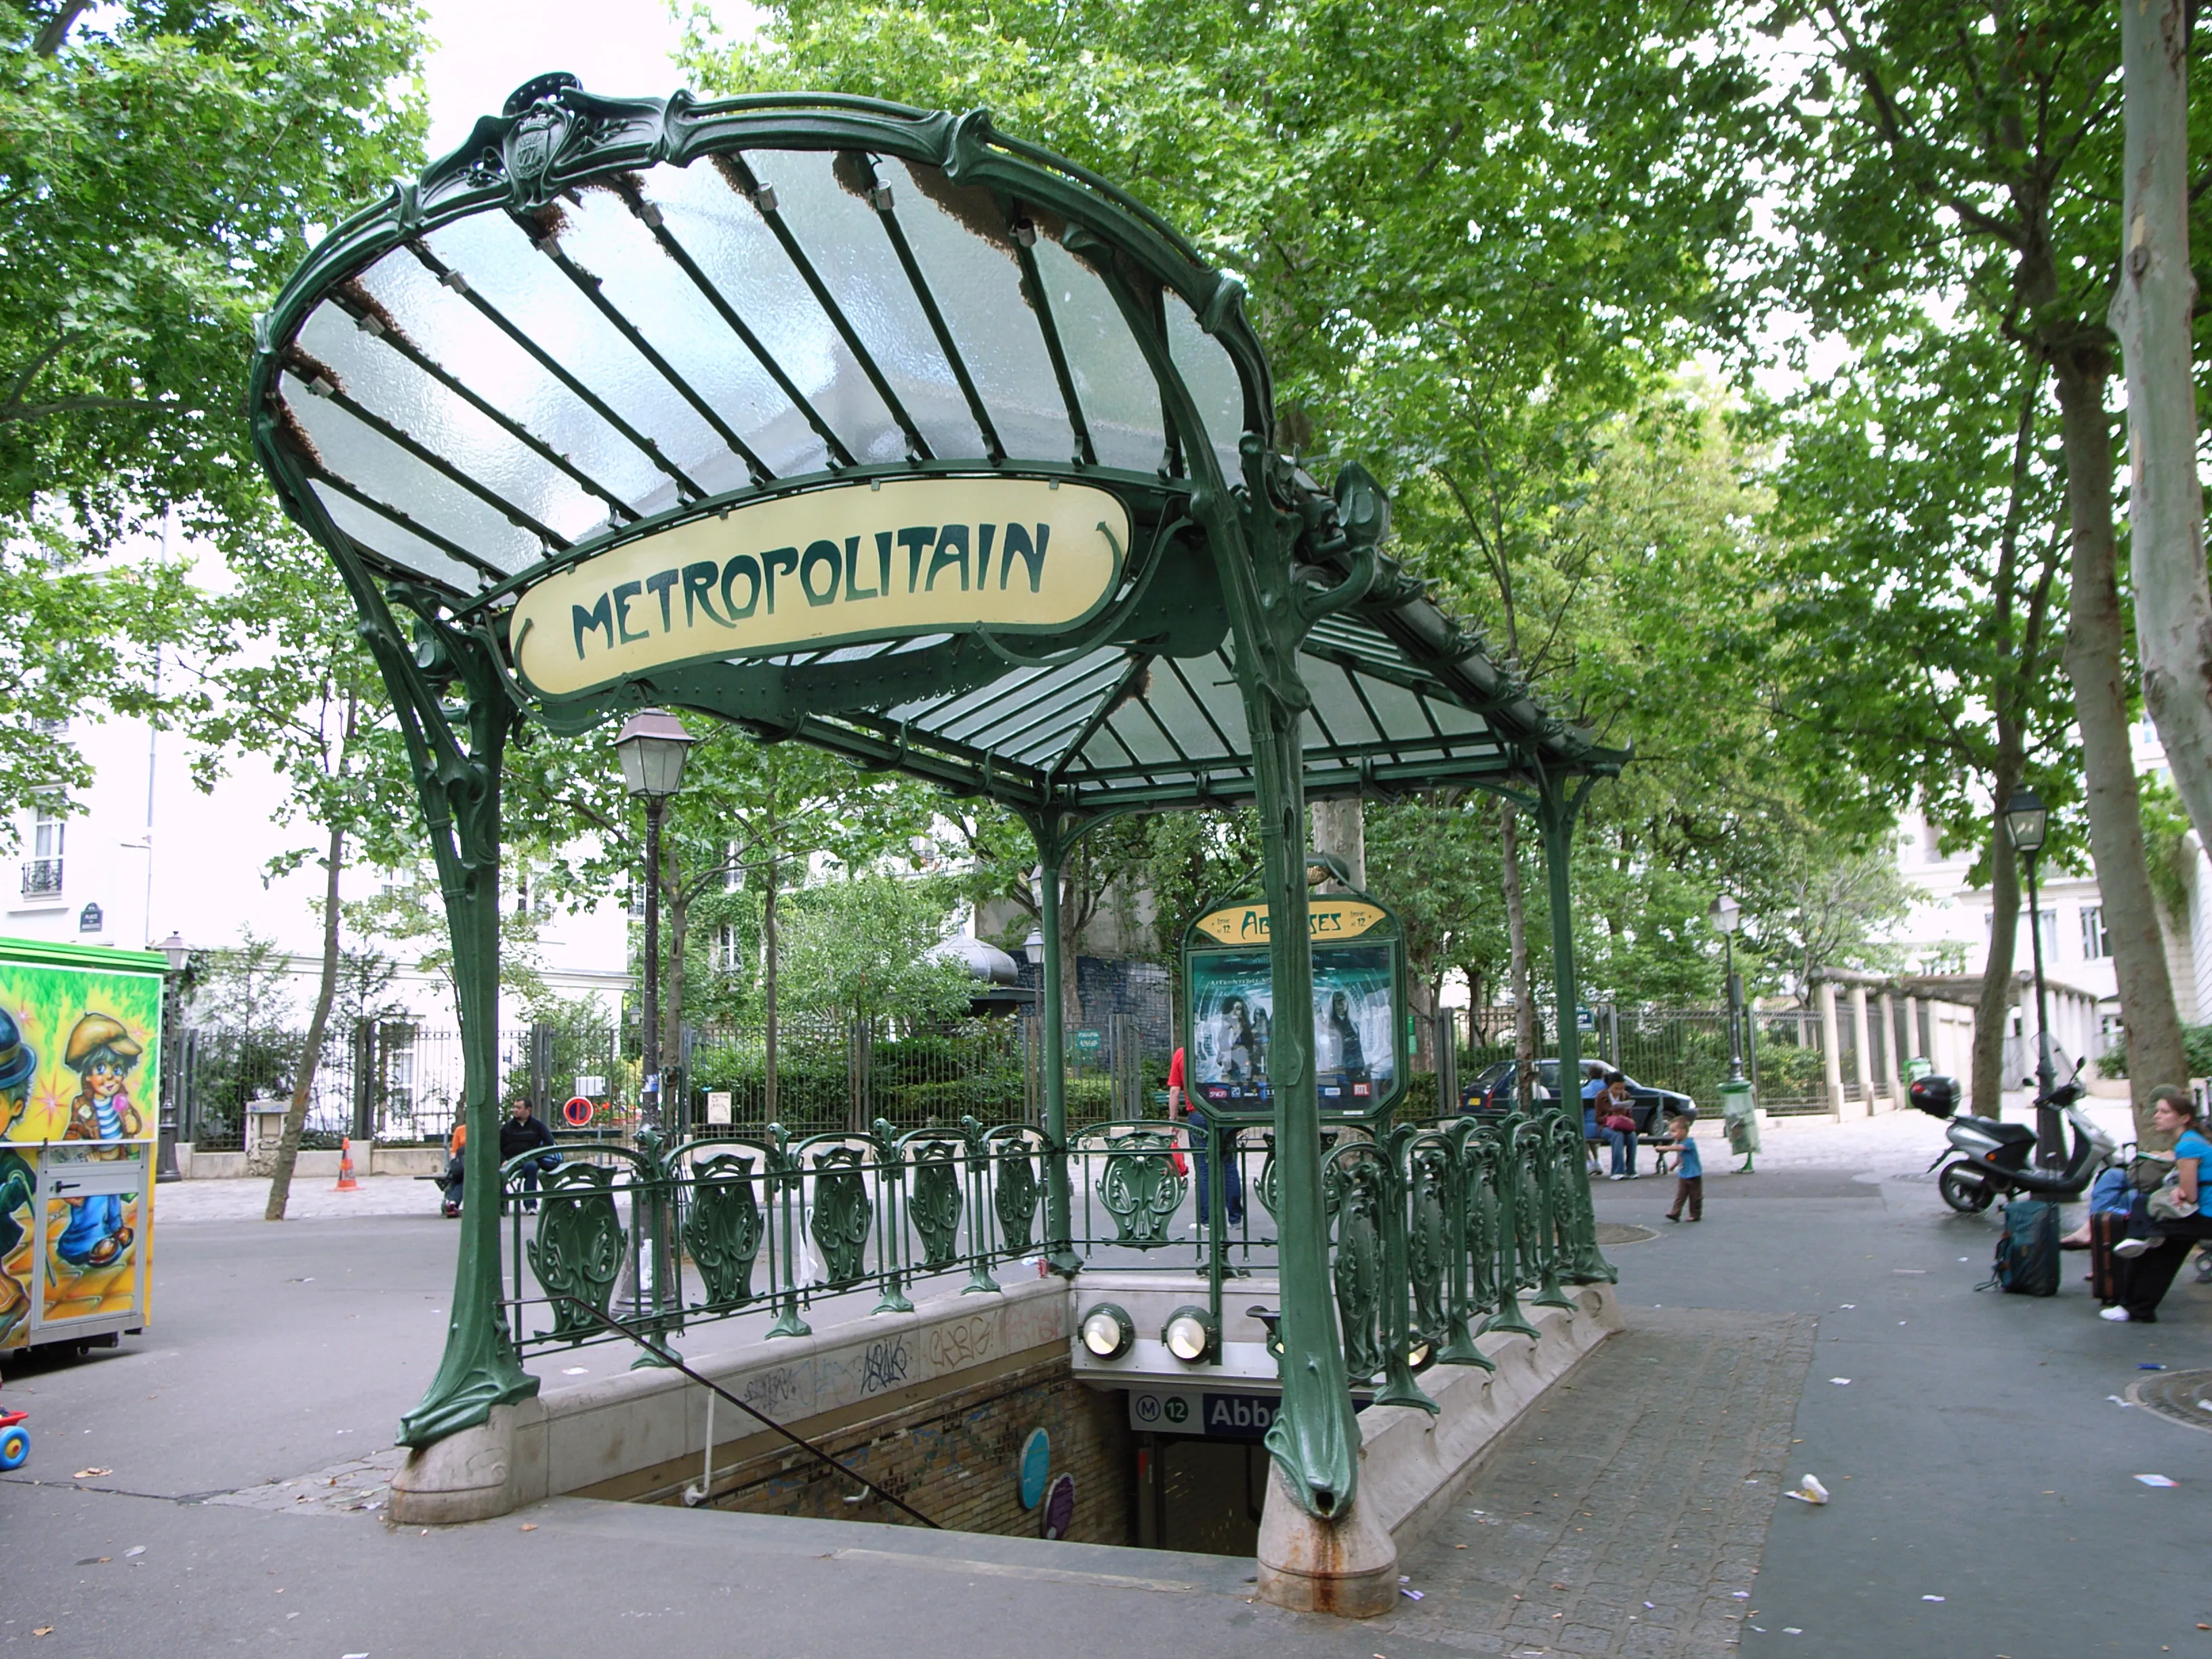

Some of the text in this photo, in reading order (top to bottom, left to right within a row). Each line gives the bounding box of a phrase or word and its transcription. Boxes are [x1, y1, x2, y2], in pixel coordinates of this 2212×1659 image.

[573, 523, 1049, 661] METROPOLITAIN
[1242, 911, 1341, 940] ABSES
[1141, 1401, 1155, 1417] M
[1166, 1402, 1186, 1418] 12
